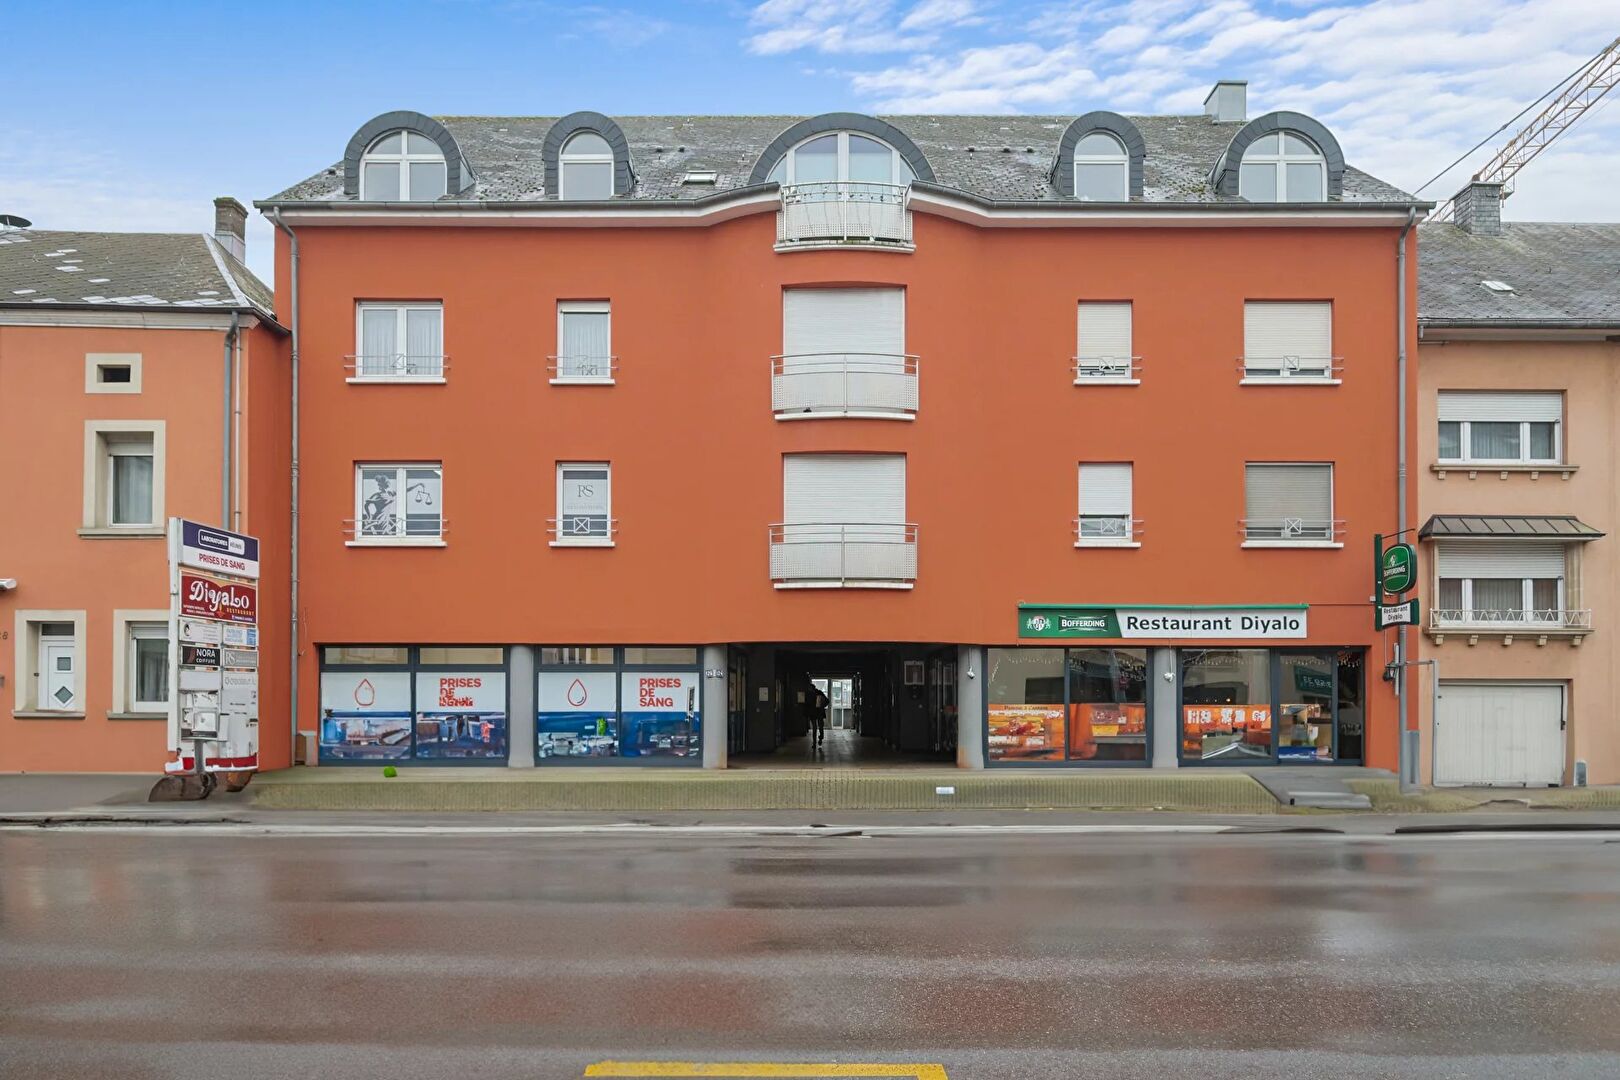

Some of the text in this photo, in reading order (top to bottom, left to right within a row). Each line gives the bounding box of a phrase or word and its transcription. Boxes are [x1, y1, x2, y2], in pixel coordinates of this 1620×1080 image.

[198, 553, 246, 571] PRISES DE SANG
[1383, 605, 1408, 614] Restaurant
[1387, 613, 1403, 622] Diyalo
[1061, 615, 1300, 634] BOFFERDING Restaurant Diyalo
[196, 648, 216, 658] NORA
[440, 677, 482, 688] PRISES
[639, 678, 682, 688] PRISES
[639, 687, 655, 698] DE
[639, 697, 674, 708] SANG
